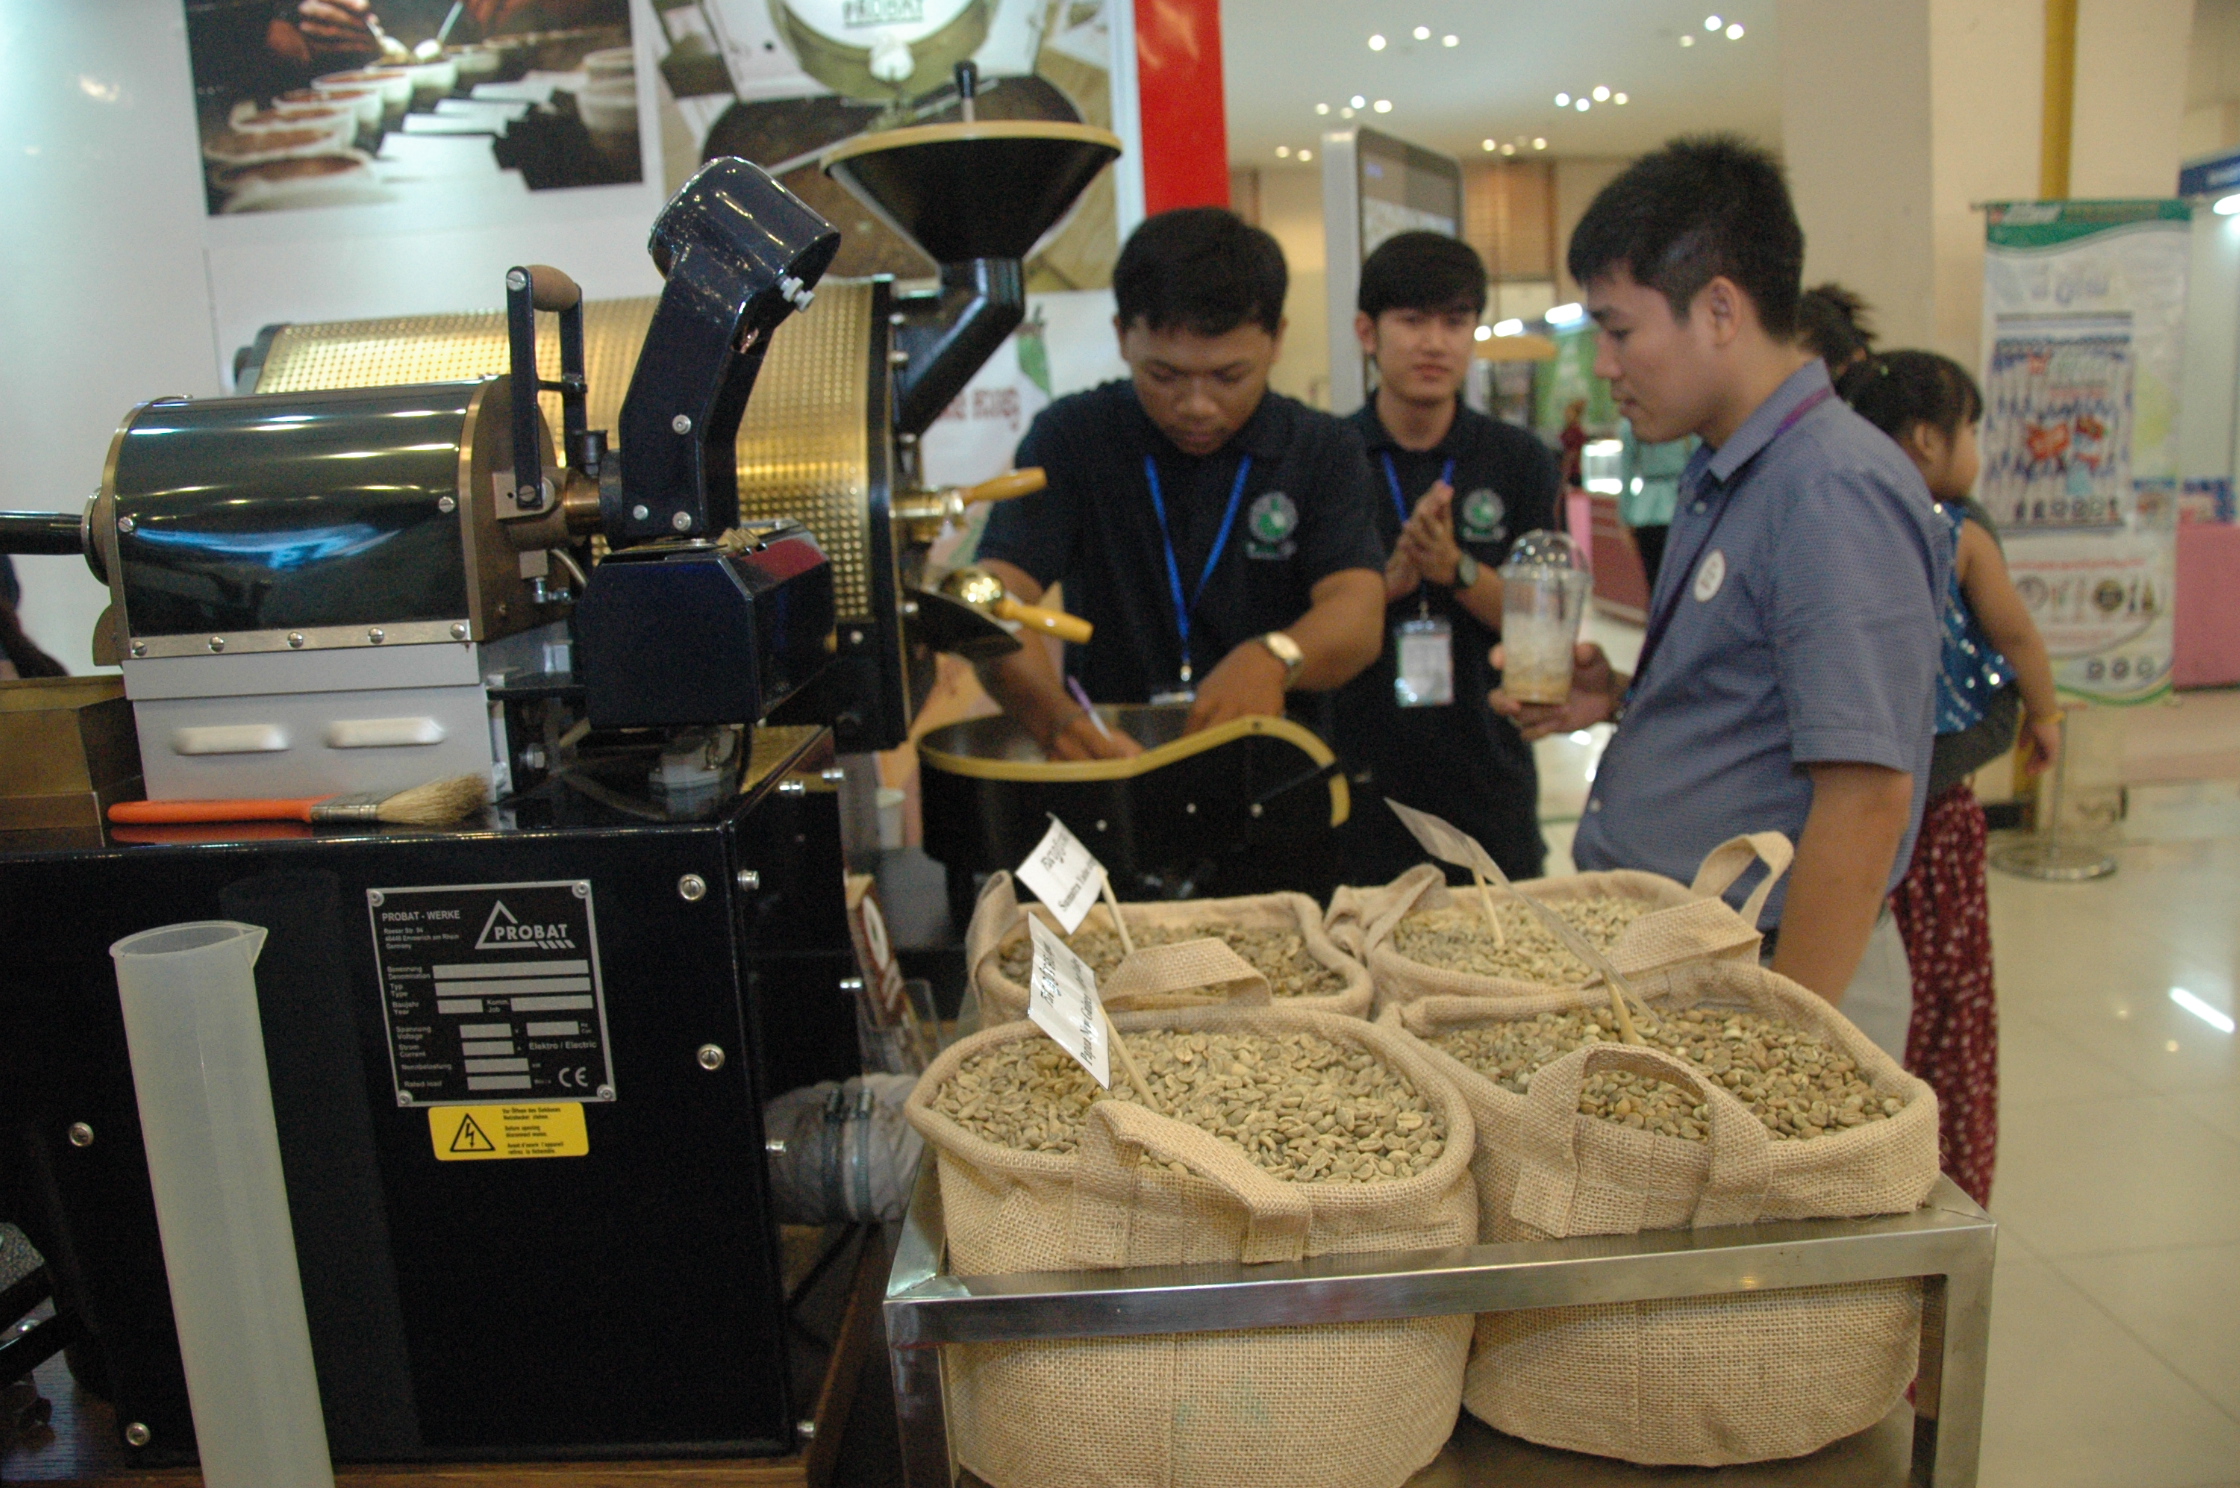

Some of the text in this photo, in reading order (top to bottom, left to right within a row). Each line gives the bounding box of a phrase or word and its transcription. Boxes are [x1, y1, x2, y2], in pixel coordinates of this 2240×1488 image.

[382, 911, 419, 922] PROBAT
[426, 910, 461, 920] WERKE
[494, 923, 568, 941] PROBAT
[528, 1042, 559, 1050] Elektro
[565, 1041, 597, 1049] Electric
[1080, 1038, 1096, 1066] Papua
